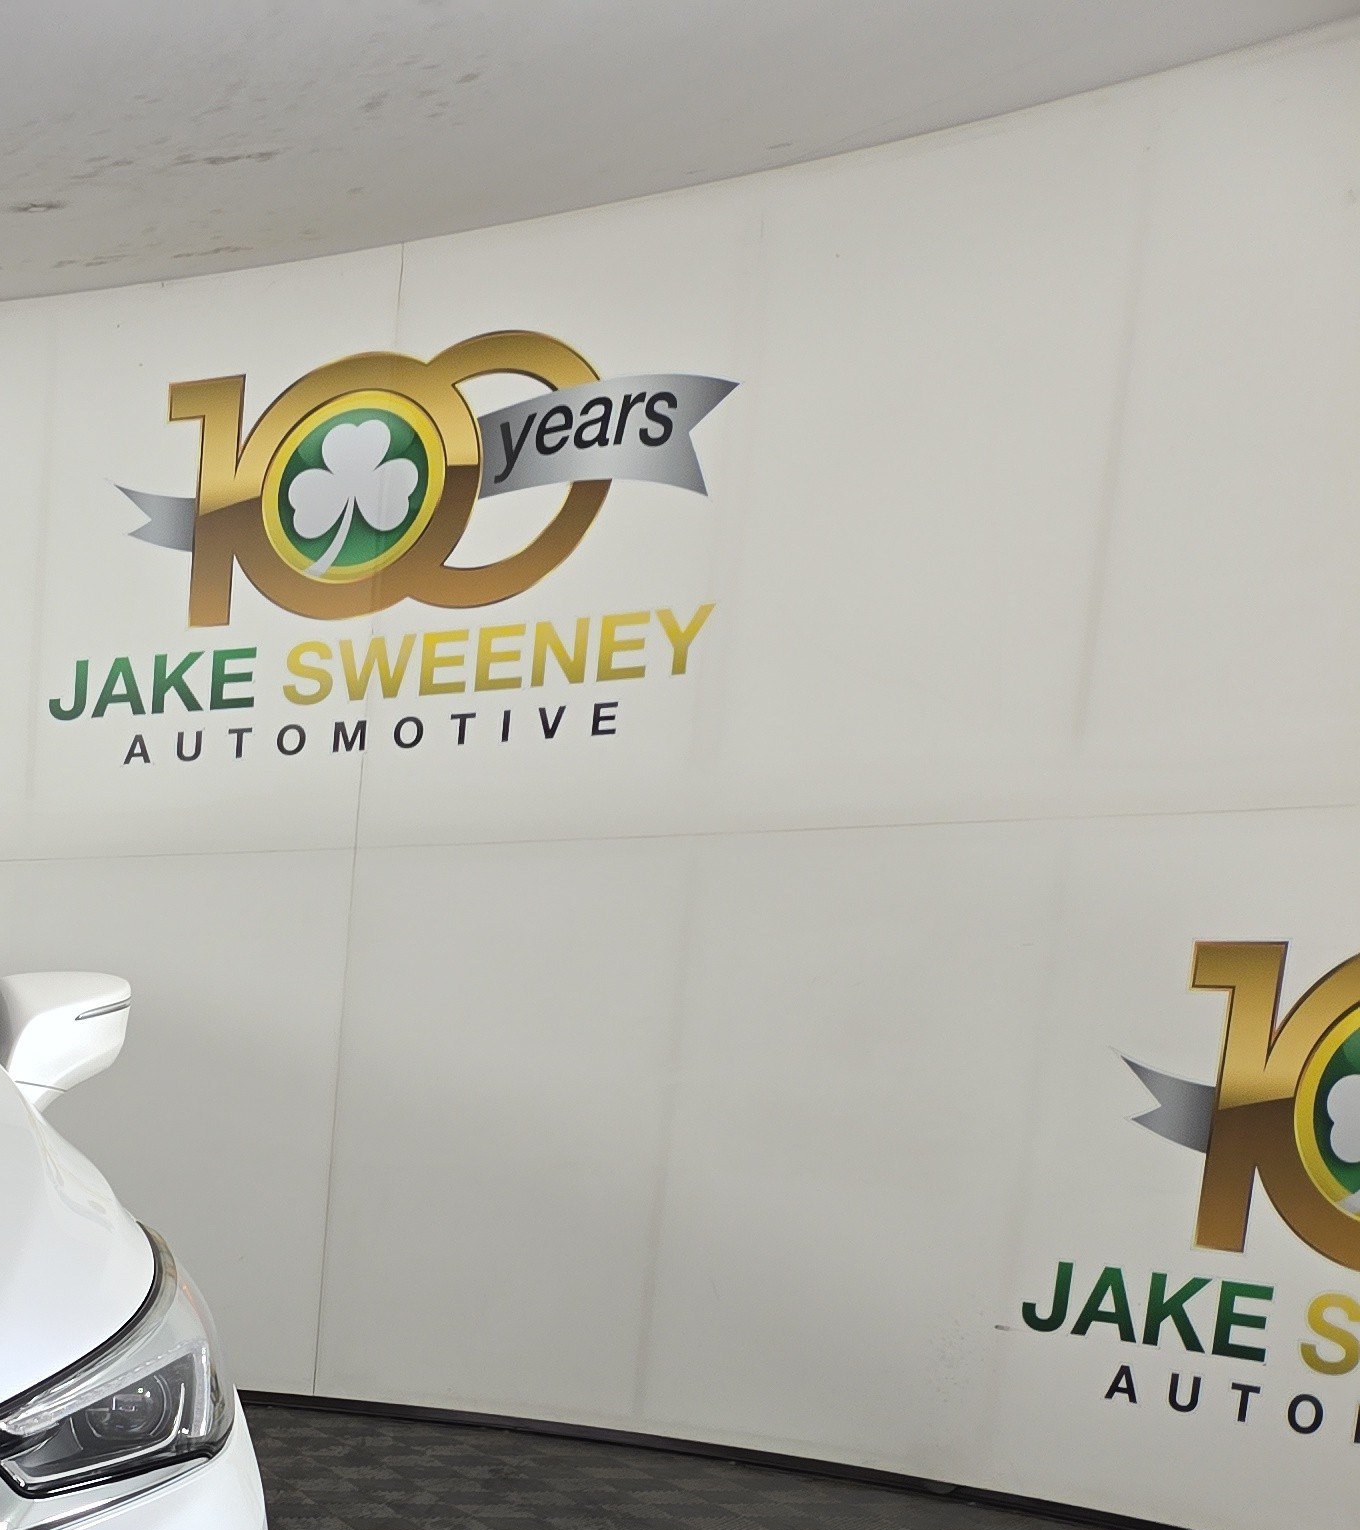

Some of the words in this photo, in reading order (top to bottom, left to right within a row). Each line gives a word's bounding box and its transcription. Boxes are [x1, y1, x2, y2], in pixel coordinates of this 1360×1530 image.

[167, 329, 612, 628] 100
[492, 389, 679, 484] years
[48, 646, 258, 721] JAKE
[282, 603, 717, 706] SWEENEY
[122, 701, 620, 766] AUTOMOTIVE
[1021, 1261, 1275, 1363] JAKE
